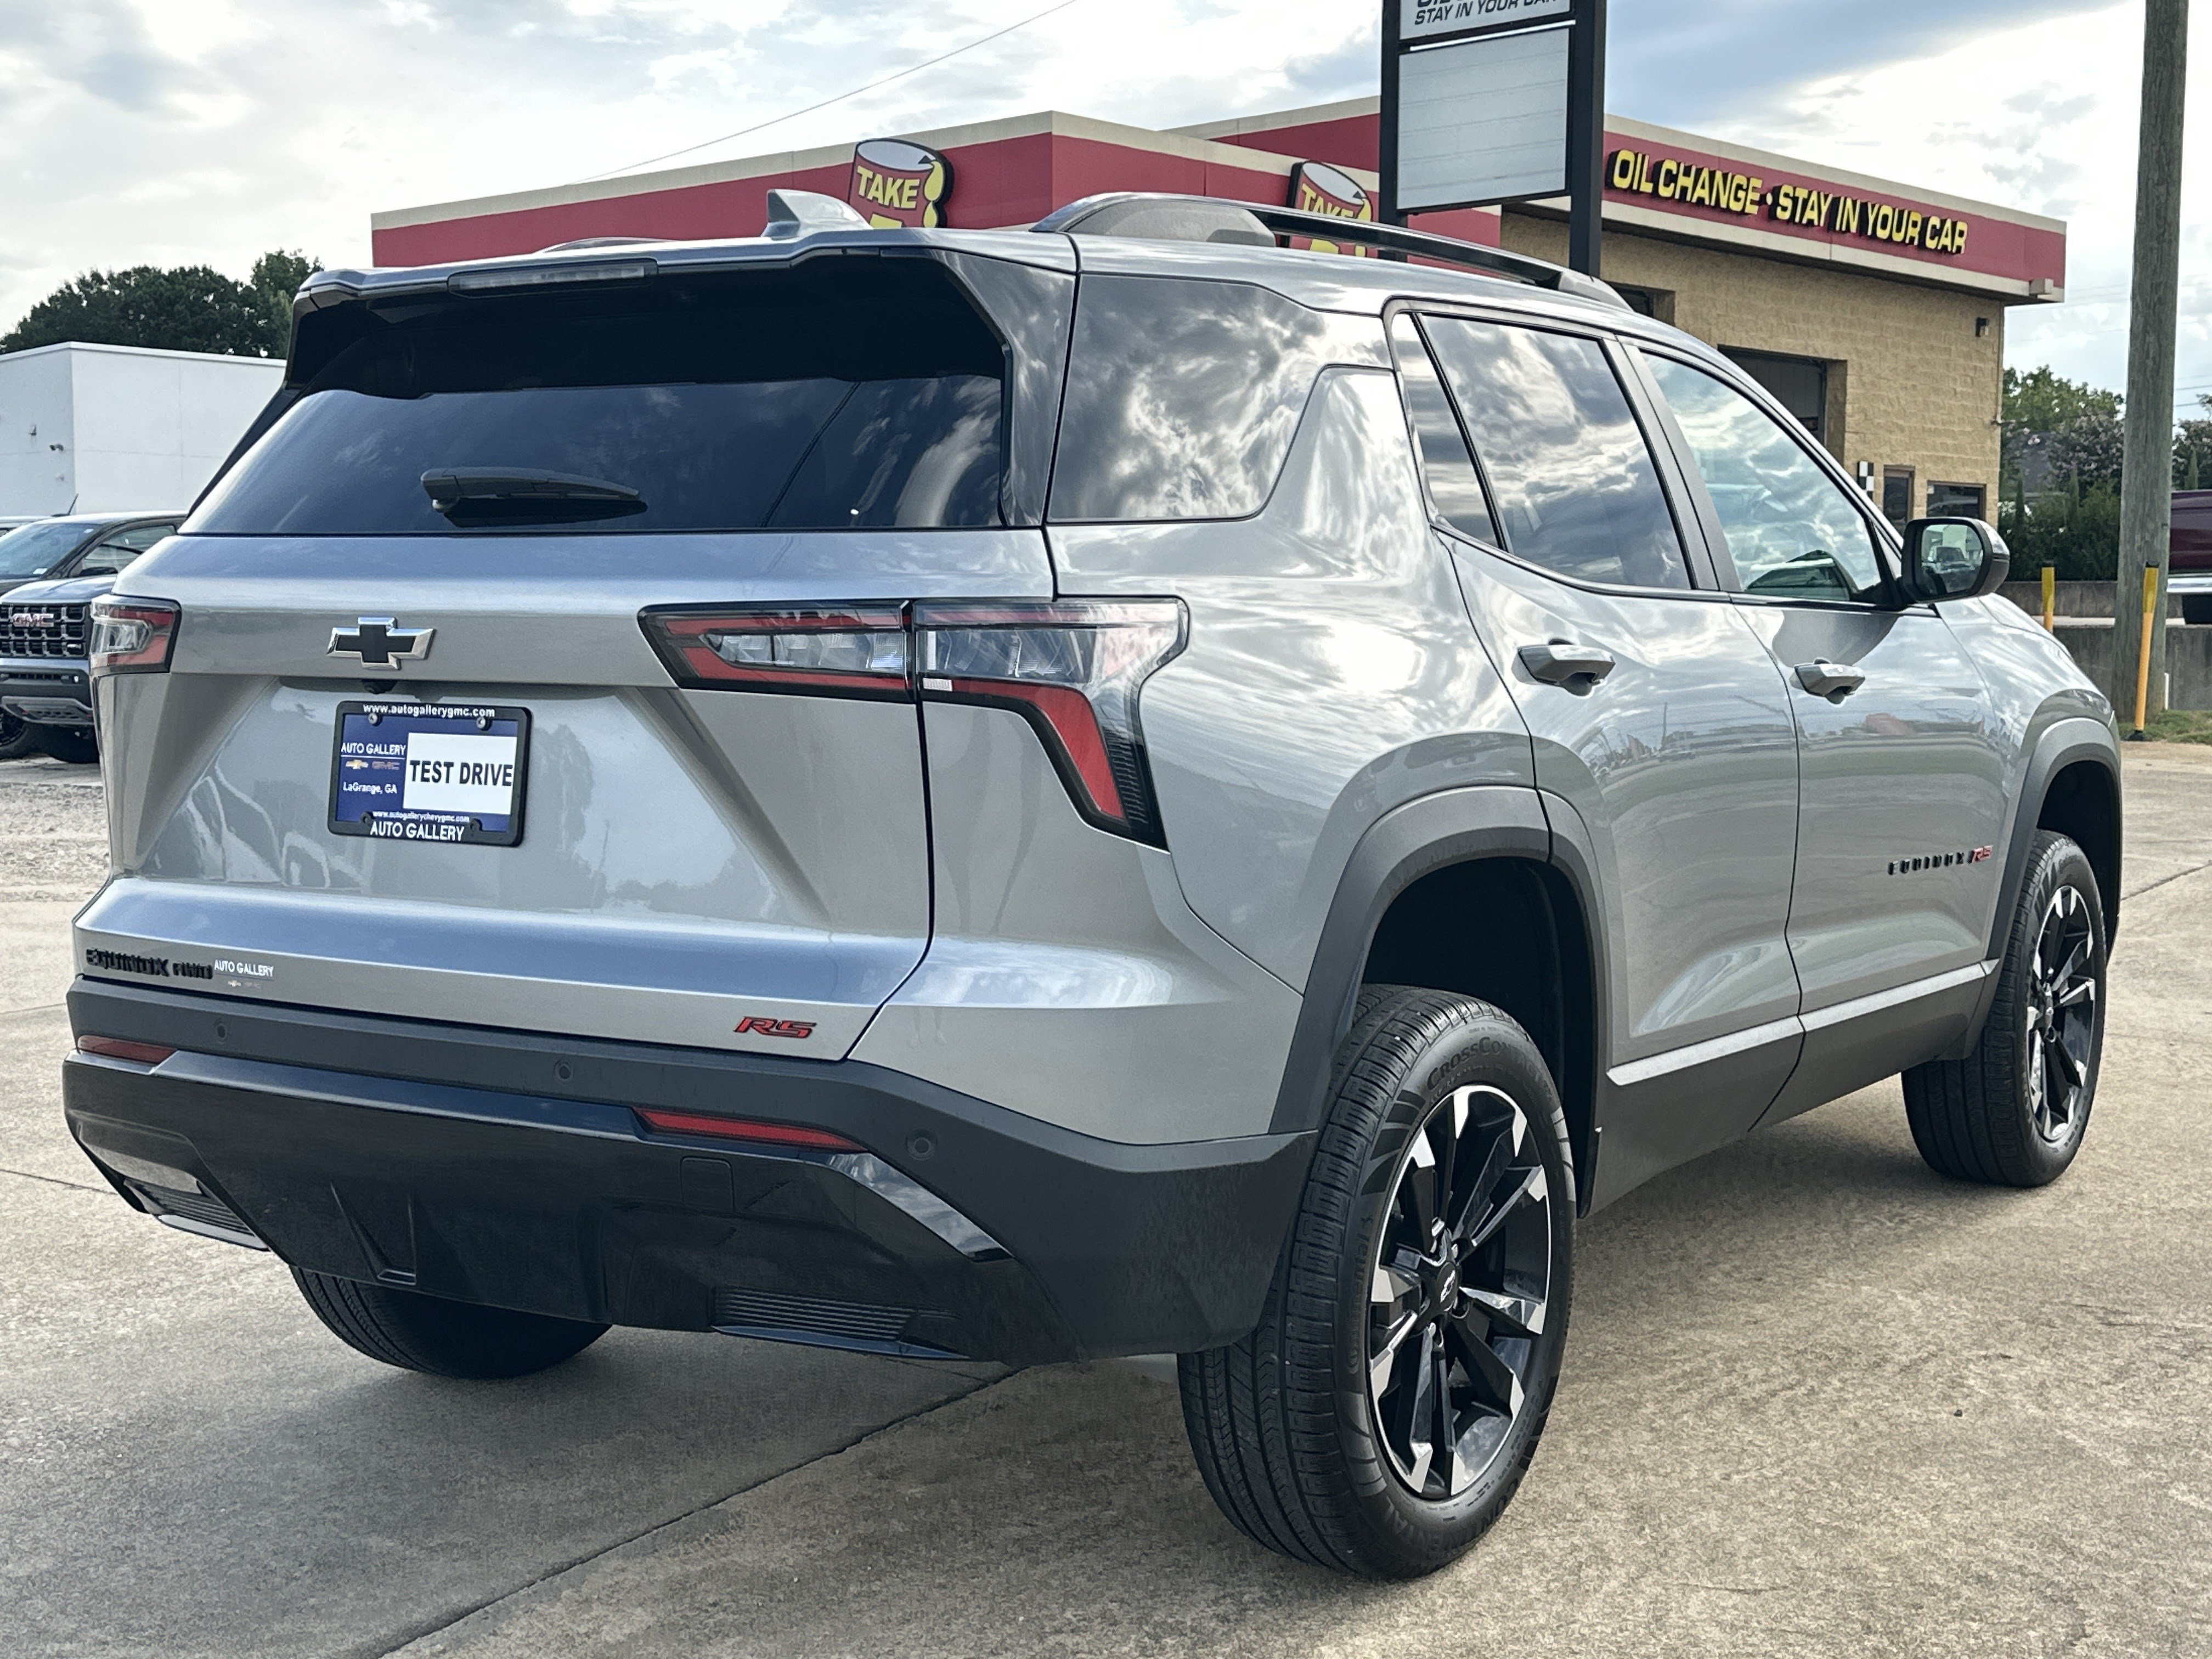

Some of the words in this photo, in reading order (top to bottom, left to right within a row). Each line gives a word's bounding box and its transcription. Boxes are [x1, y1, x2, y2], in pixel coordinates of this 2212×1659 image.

[1415, 5, 1453, 25] STAY
[1455, 2, 1473, 18] IN
[856, 165, 920, 208] TAKE
[1301, 183, 1355, 217] TA
[1612, 150, 1652, 193] OIL
[1657, 160, 1762, 215] CHANGE
[1777, 185, 1832, 227] STAY
[1835, 196, 1861, 233] IN
[1866, 202, 1922, 246] YOUR
[1926, 216, 1968, 254] CAR
[12, 613, 54, 627] GMC
[363, 704, 495, 718] www.autogallerygmc.com
[341, 743, 365, 753] AUTO
[366, 743, 406, 755] GALLERY
[410, 760, 454, 783] TEST
[459, 763, 513, 787] DRIVE
[385, 783, 397, 793] GA
[370, 821, 403, 837] AUTO
[406, 823, 465, 841] GALLERY
[1967, 845, 1994, 864] RS
[215, 960, 235, 972] AUTO
[236, 962, 274, 977] GALLERY
[732, 1016, 817, 1039] RS
